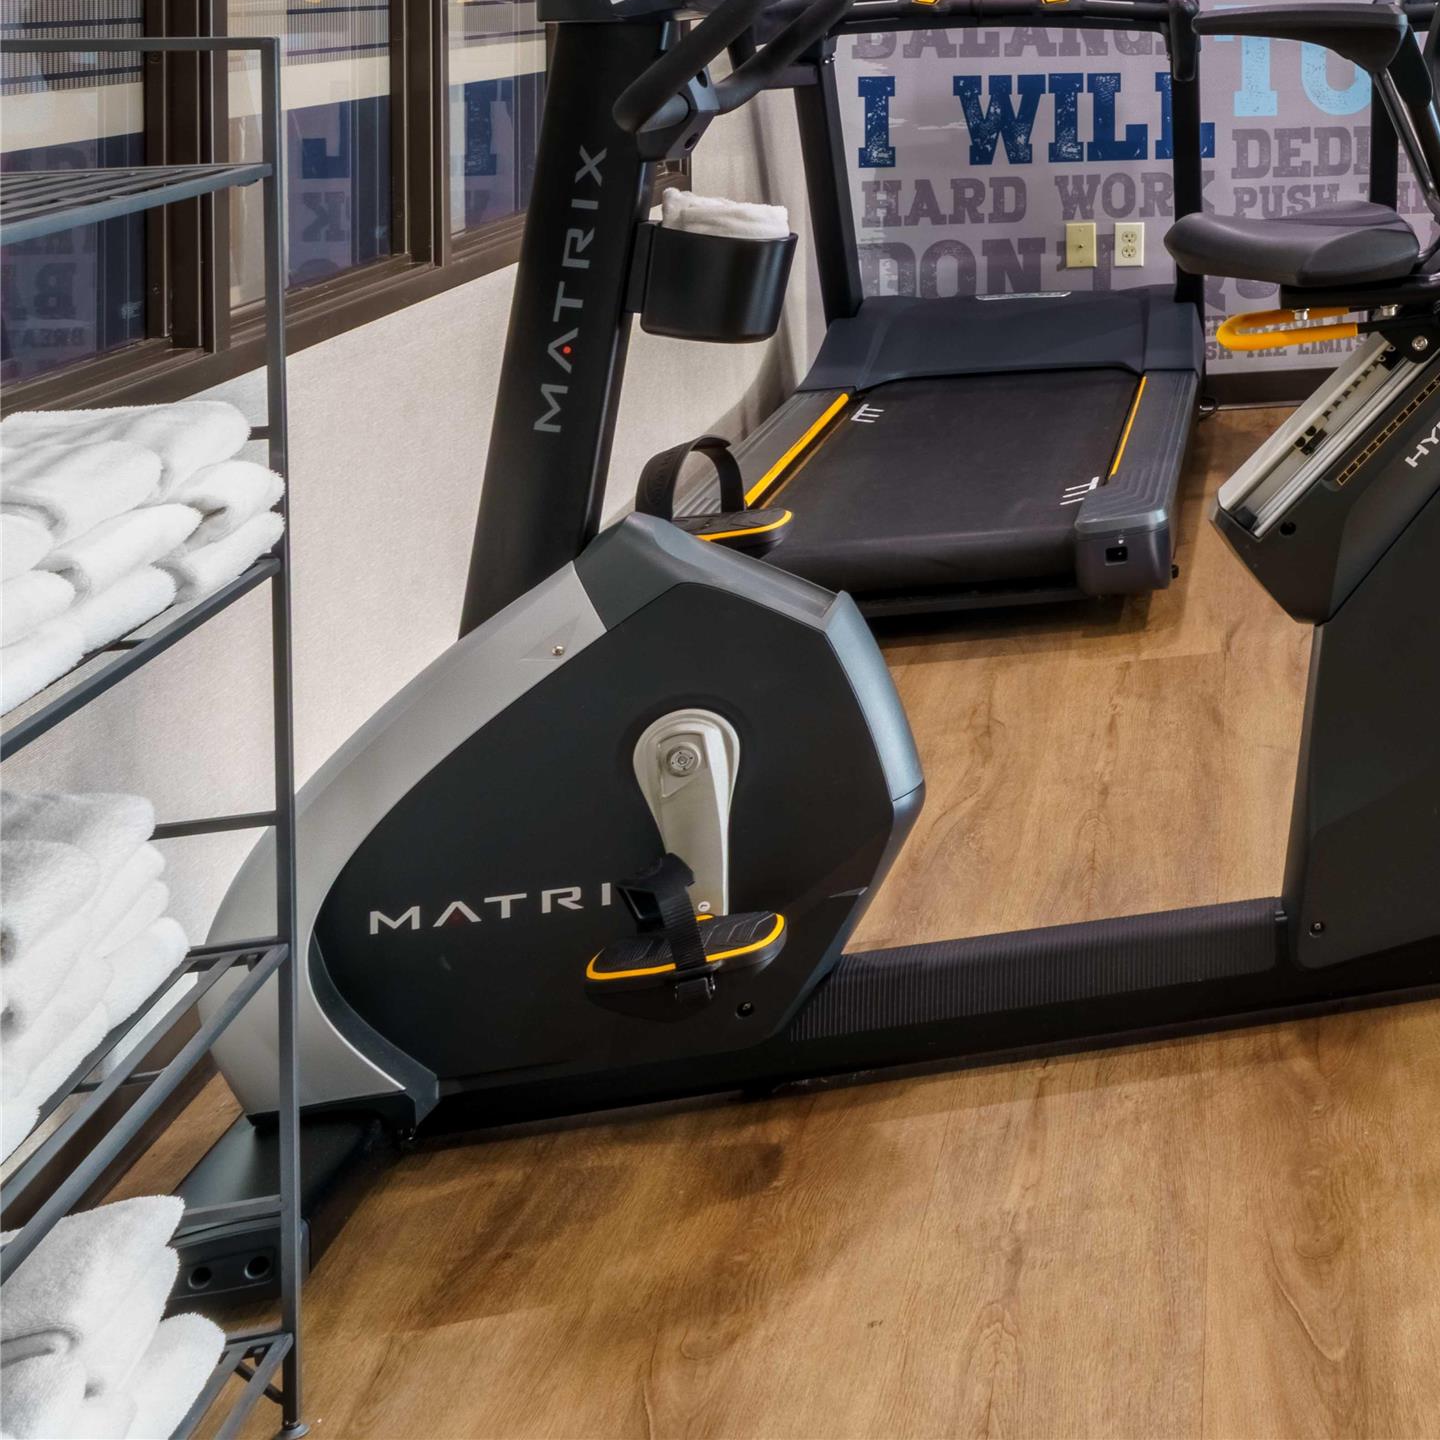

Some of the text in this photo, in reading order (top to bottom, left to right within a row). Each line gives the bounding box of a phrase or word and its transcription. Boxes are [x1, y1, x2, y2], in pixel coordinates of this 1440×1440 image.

[858, 76, 896, 168] I
[861, 176, 1027, 228] HARD
[533, 145, 608, 434] MATRIX
[370, 882, 611, 935] MATRI
